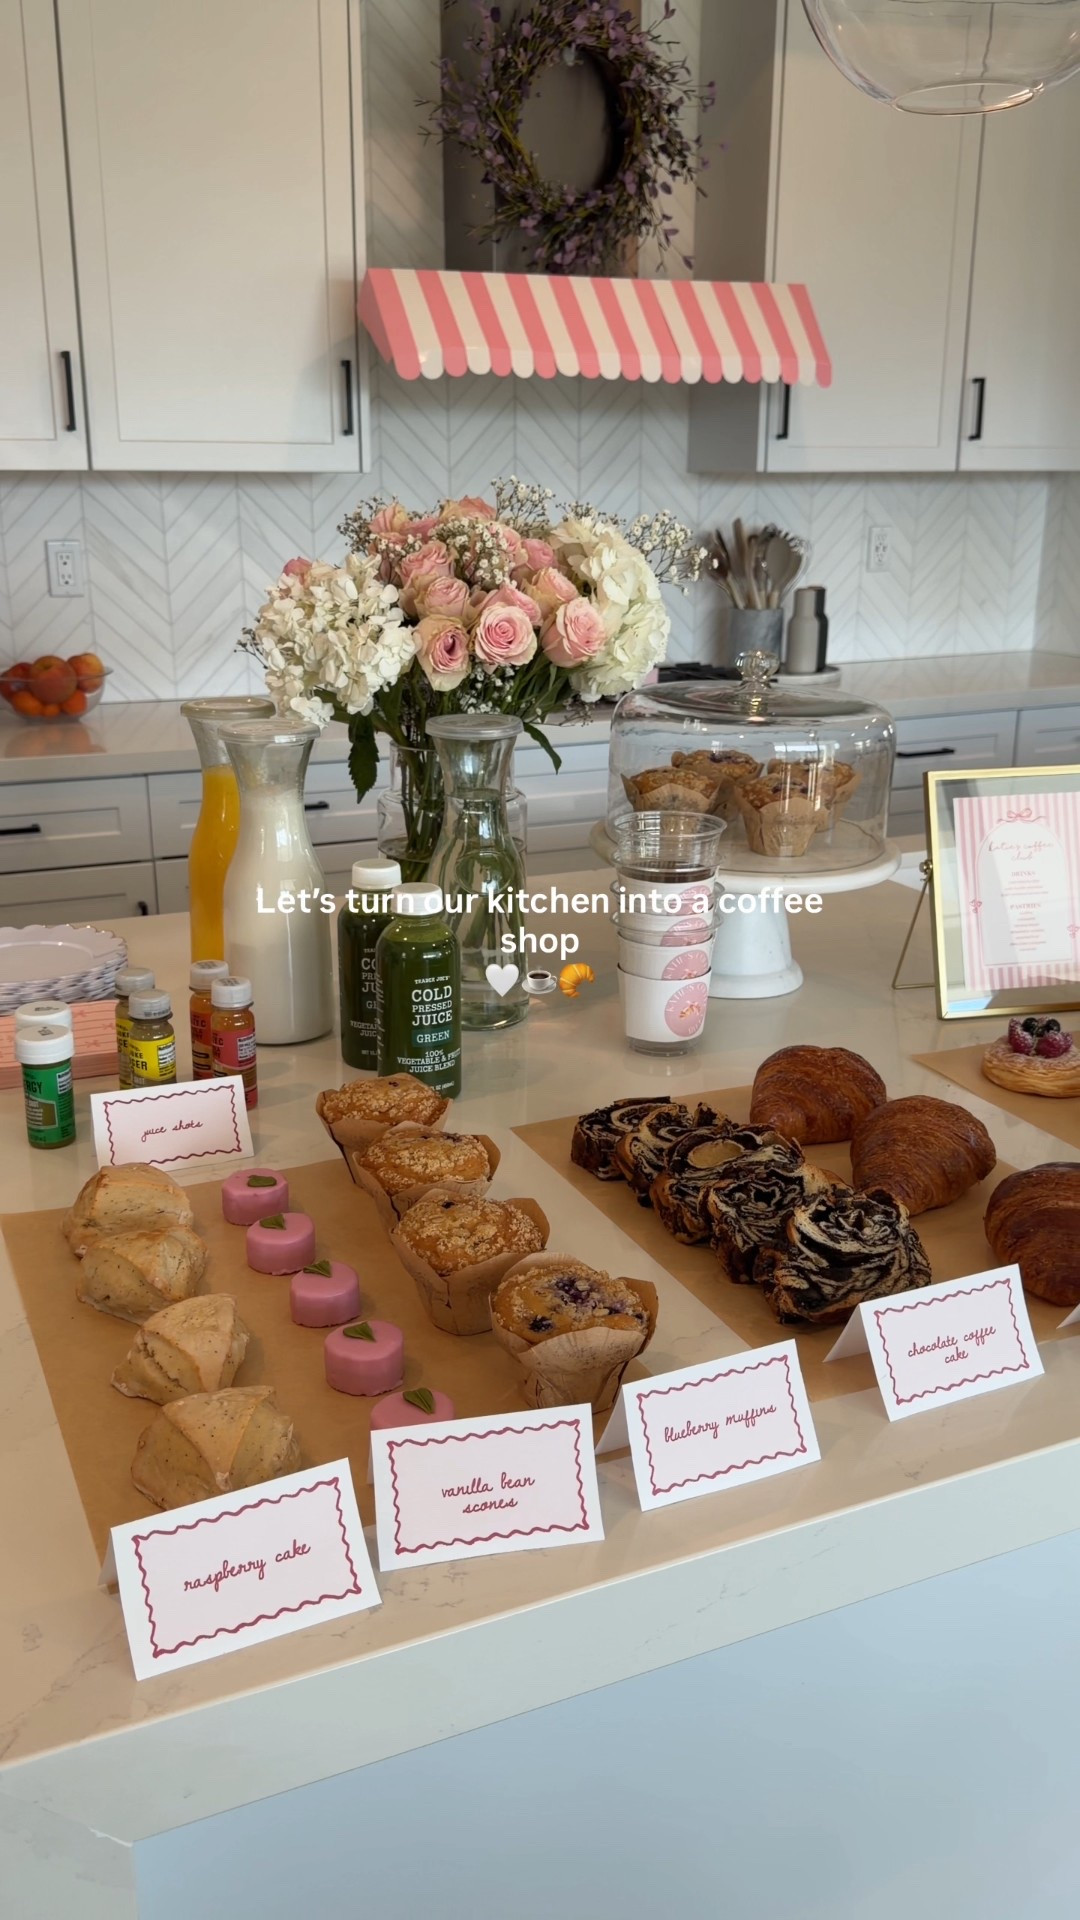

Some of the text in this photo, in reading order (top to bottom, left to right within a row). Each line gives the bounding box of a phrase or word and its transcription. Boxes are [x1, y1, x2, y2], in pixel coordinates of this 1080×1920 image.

[414, 977, 435, 985] TRADER
[411, 985, 452, 1003] COLD
[412, 1000, 452, 1013] PRESSED
[412, 1010, 452, 1026] JUICE
[416, 1030, 450, 1044] GREEN
[397, 1056, 440, 1066] VEGETABLE
[441, 1055, 447, 1063] &
[425, 1049, 444, 1058] 100%
[409, 1060, 455, 1073] JUICE BLEND
[141, 1119, 203, 1143] juice shots
[908, 1326, 996, 1357] chocolate coffee
[944, 1346, 968, 1363] cake
[664, 1404, 776, 1443] blueberry muffins
[441, 1471, 535, 1498] vanilla bean
[462, 1498, 518, 1514] scones
[184, 1539, 311, 1592] raspberry cake
